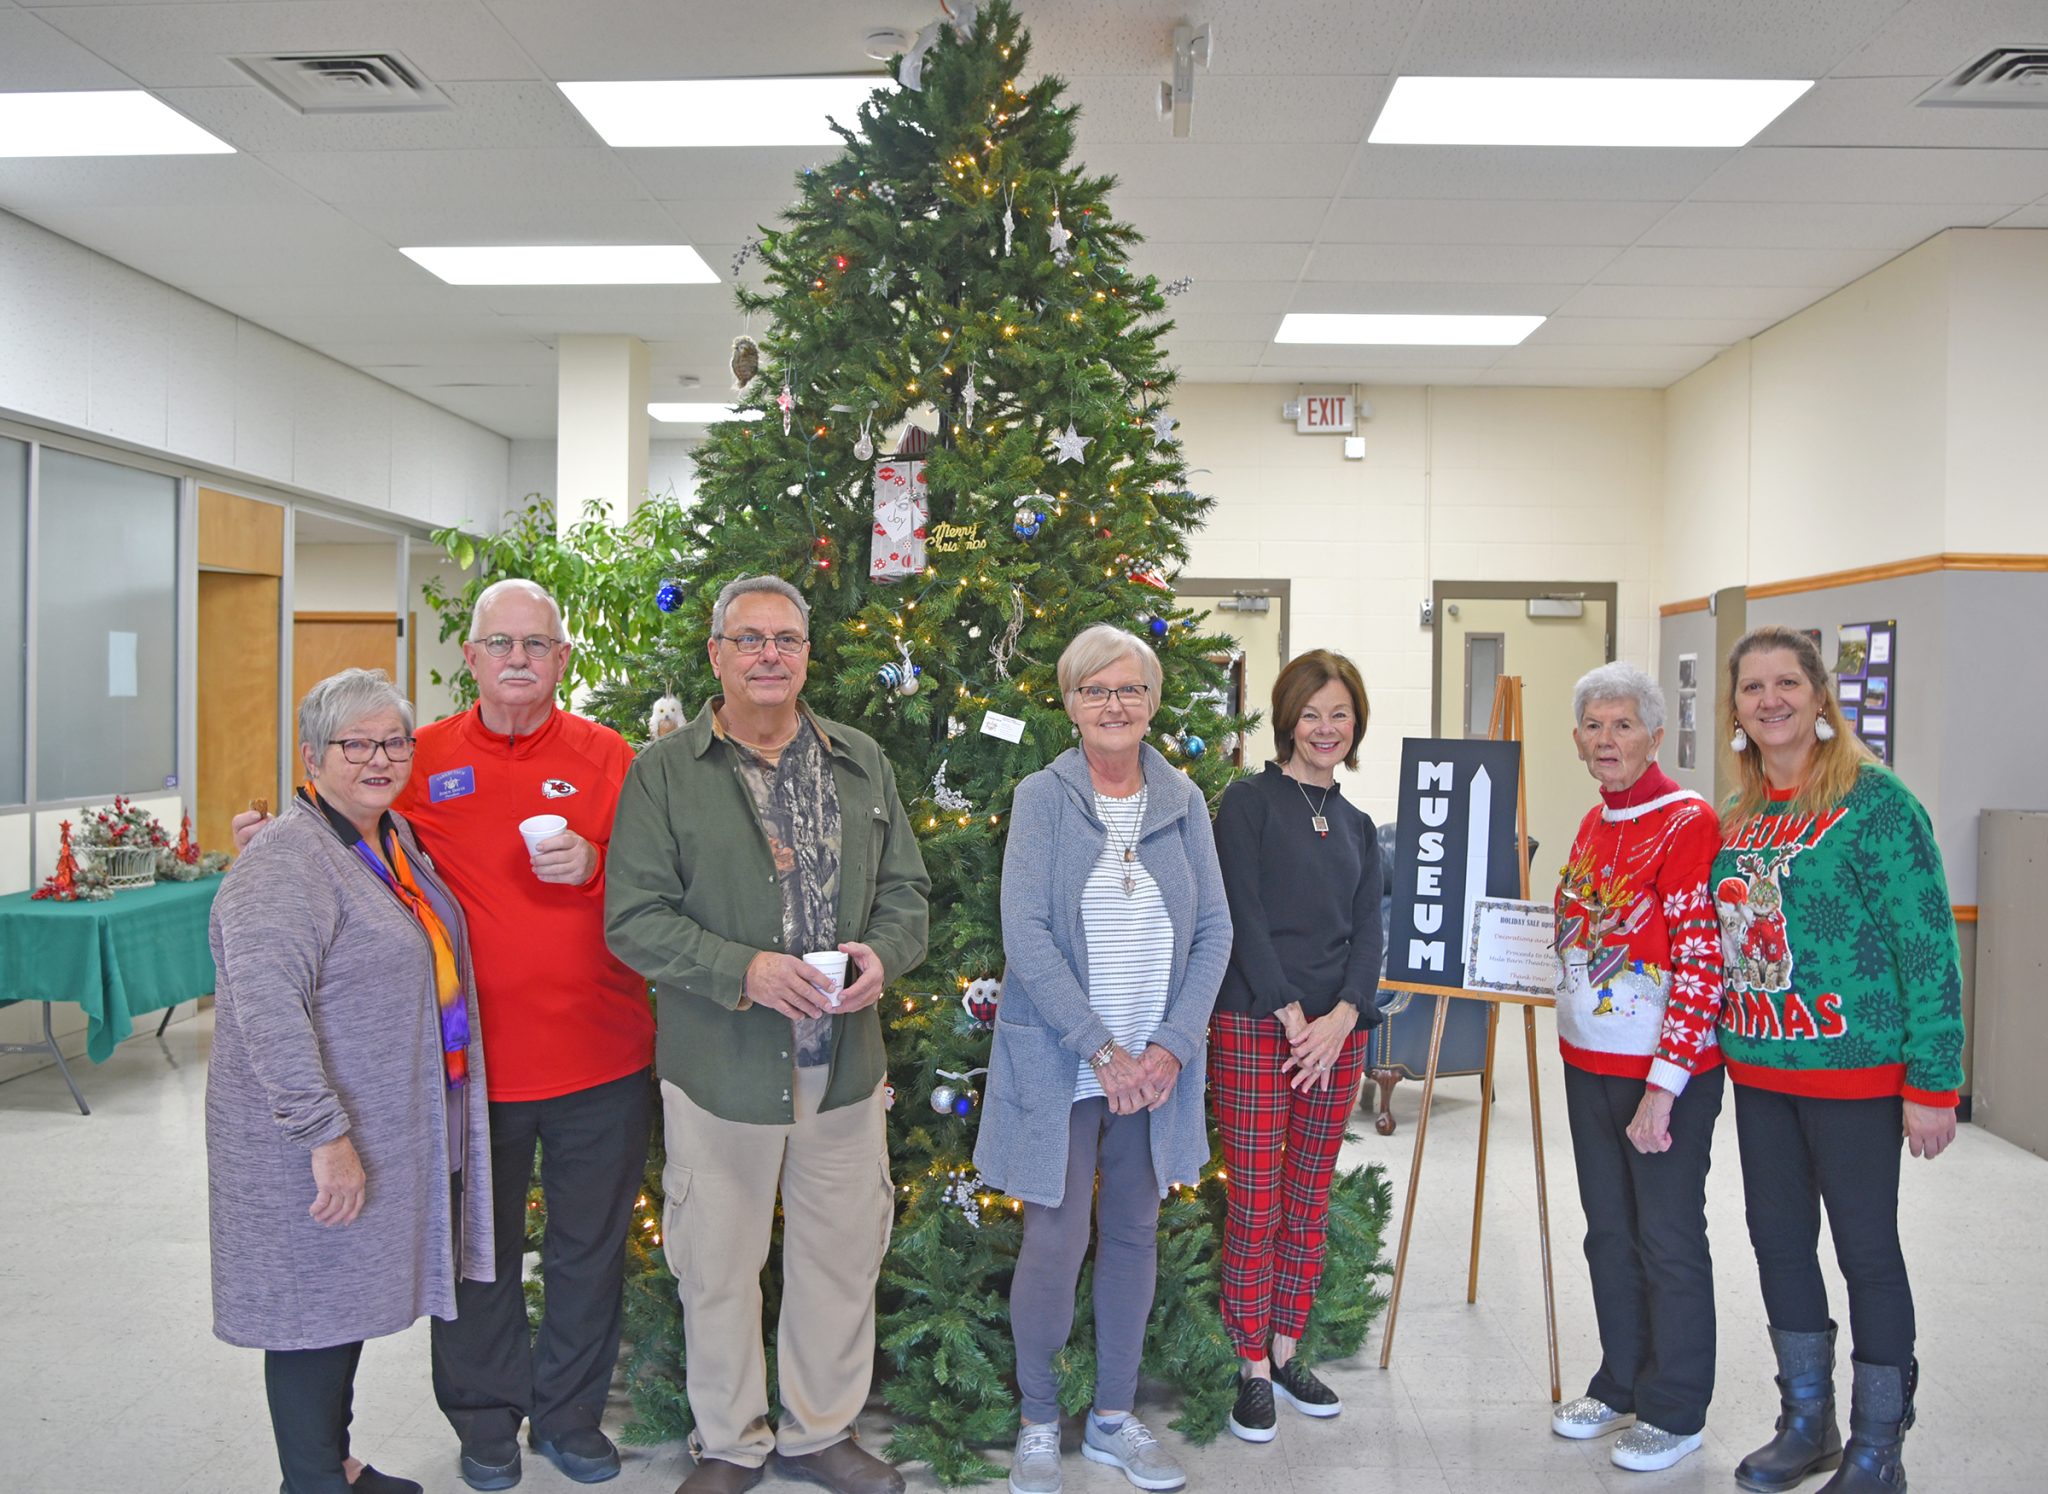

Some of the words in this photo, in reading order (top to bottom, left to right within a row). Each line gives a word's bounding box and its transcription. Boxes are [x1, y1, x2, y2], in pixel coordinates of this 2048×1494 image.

[1307, 397, 1346, 426] EXIT
[887, 508, 907, 532] Joy
[931, 520, 985, 541] Merry
[551, 782, 571, 794] KC
[1408, 761, 1454, 972] MUSEUM
[1500, 916, 1525, 926] HOLIDAY
[1526, 919, 1540, 928] SALE
